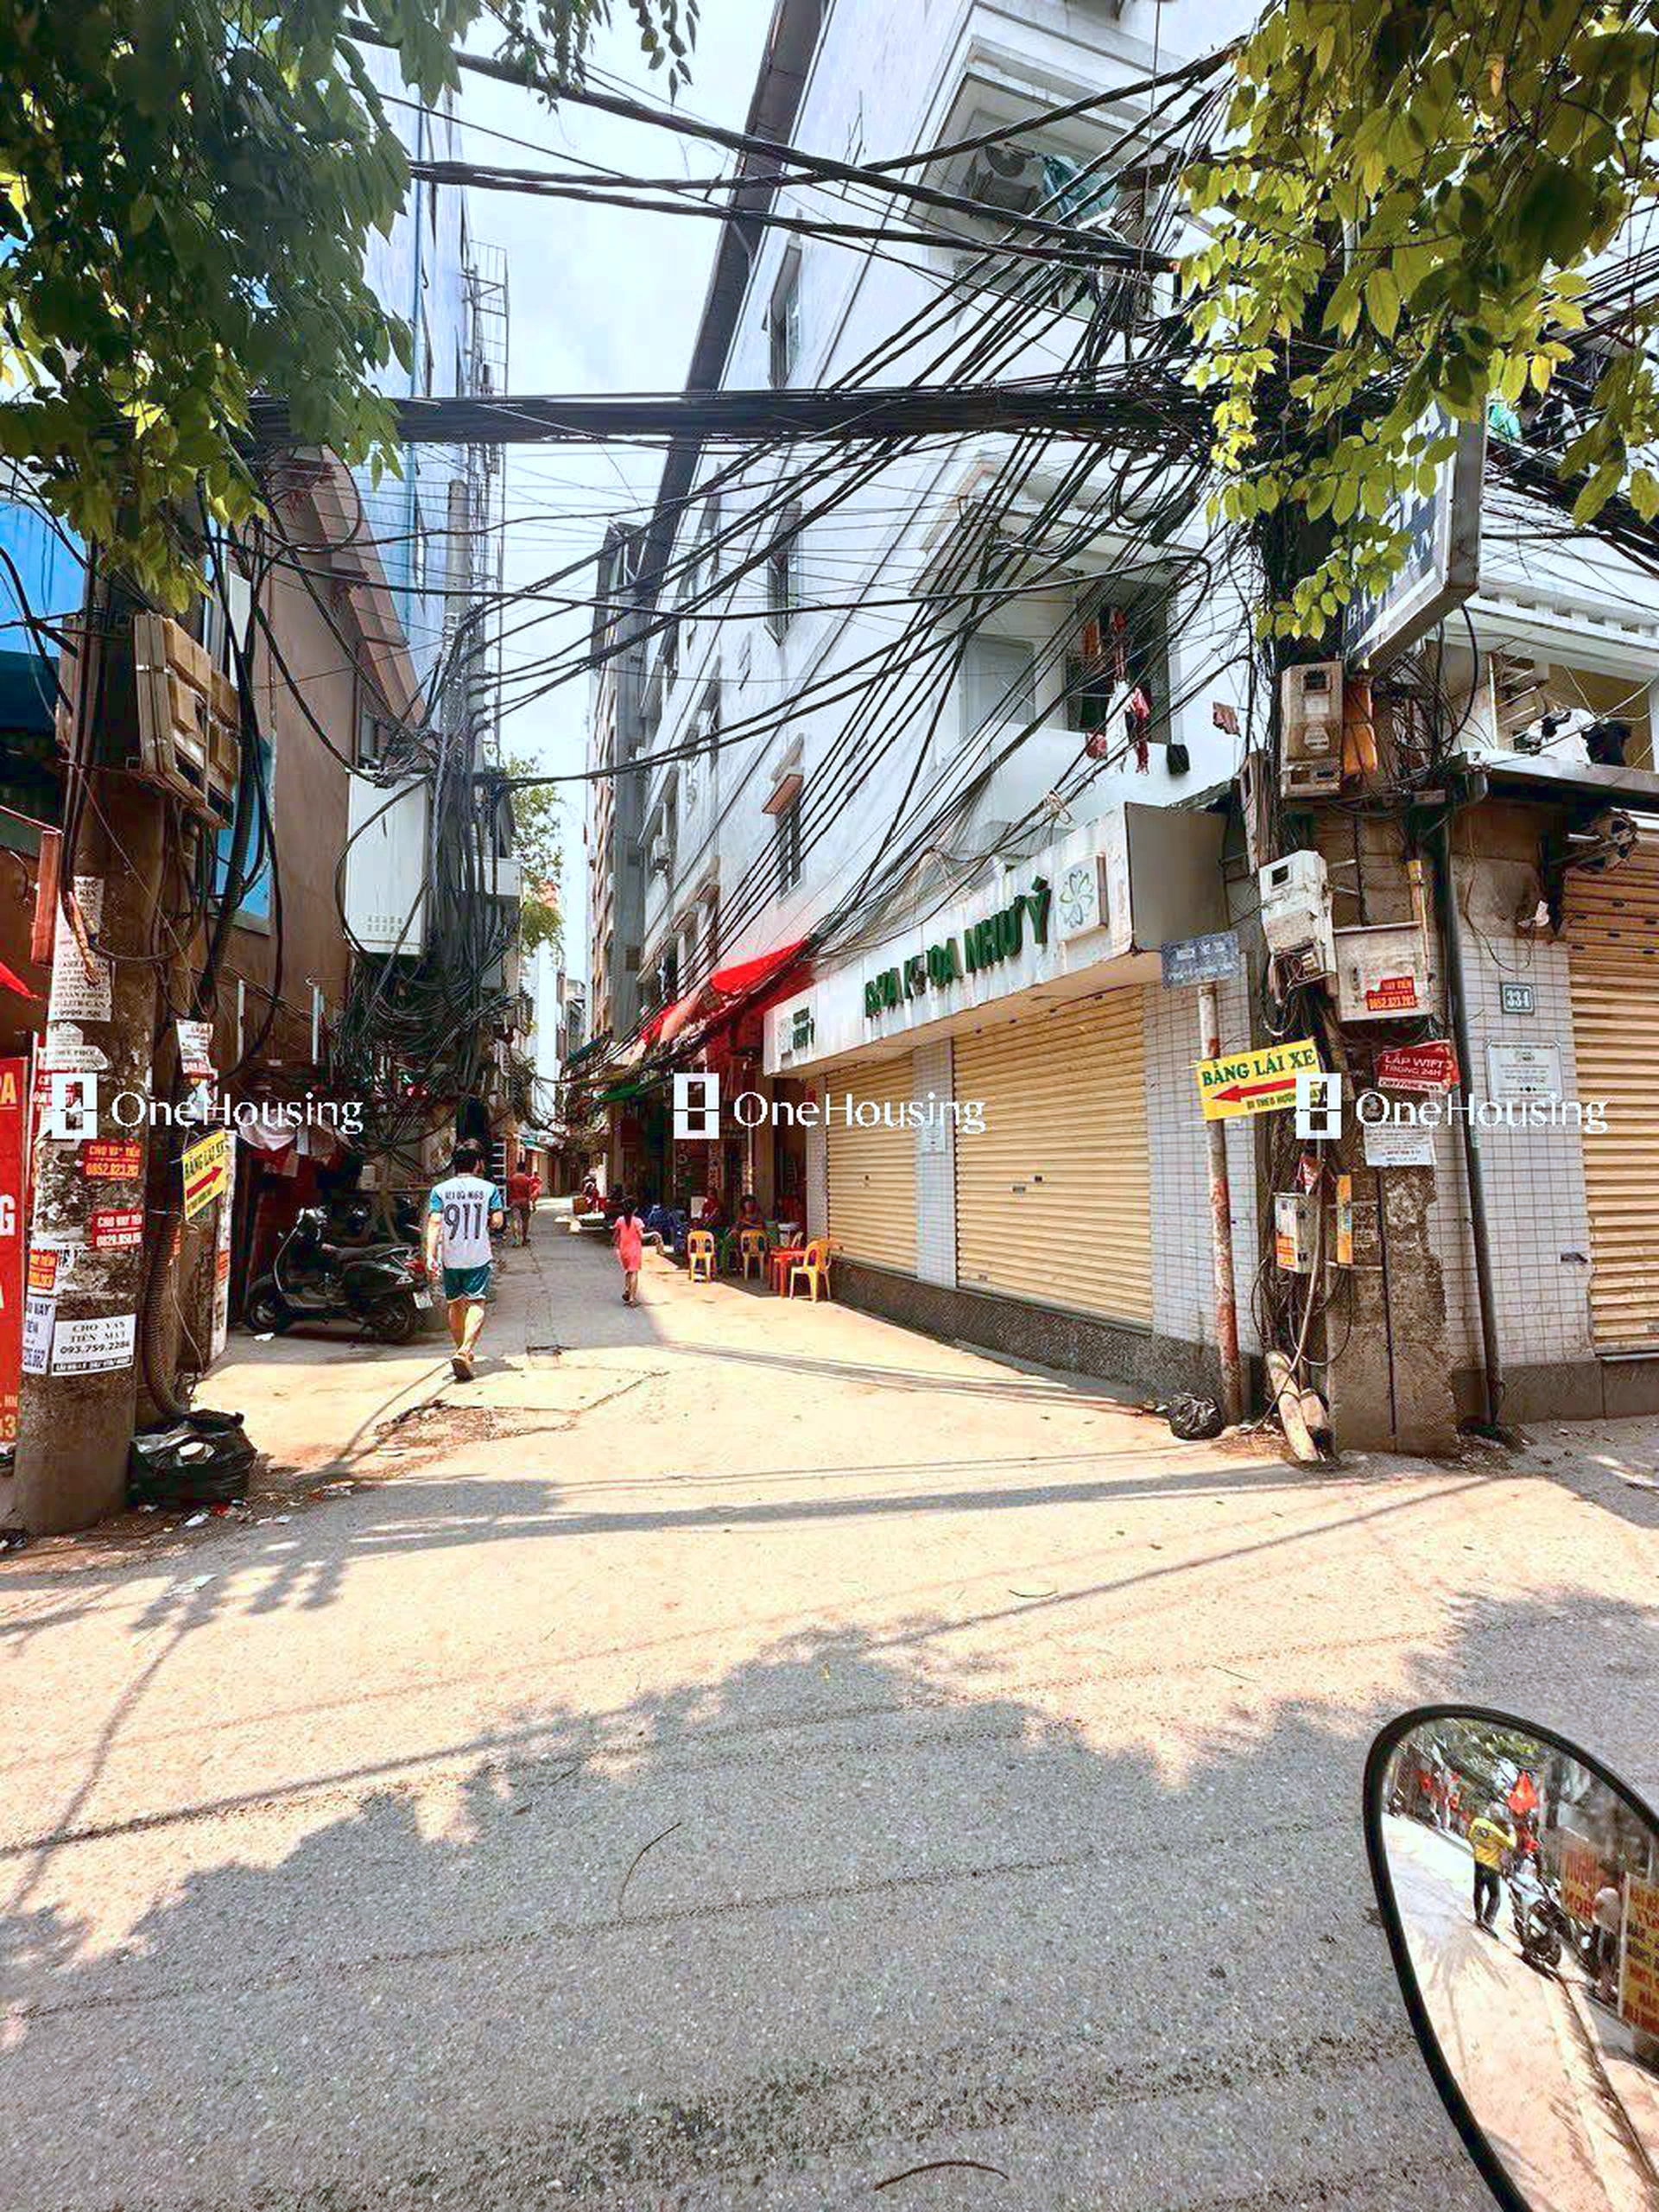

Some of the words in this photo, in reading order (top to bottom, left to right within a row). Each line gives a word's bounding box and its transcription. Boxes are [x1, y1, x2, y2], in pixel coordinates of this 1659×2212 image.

[1026, 874, 1052, 945] Ý
[1289, 1049, 1317, 1068] XE
[444, 1203, 483, 1240] 911
